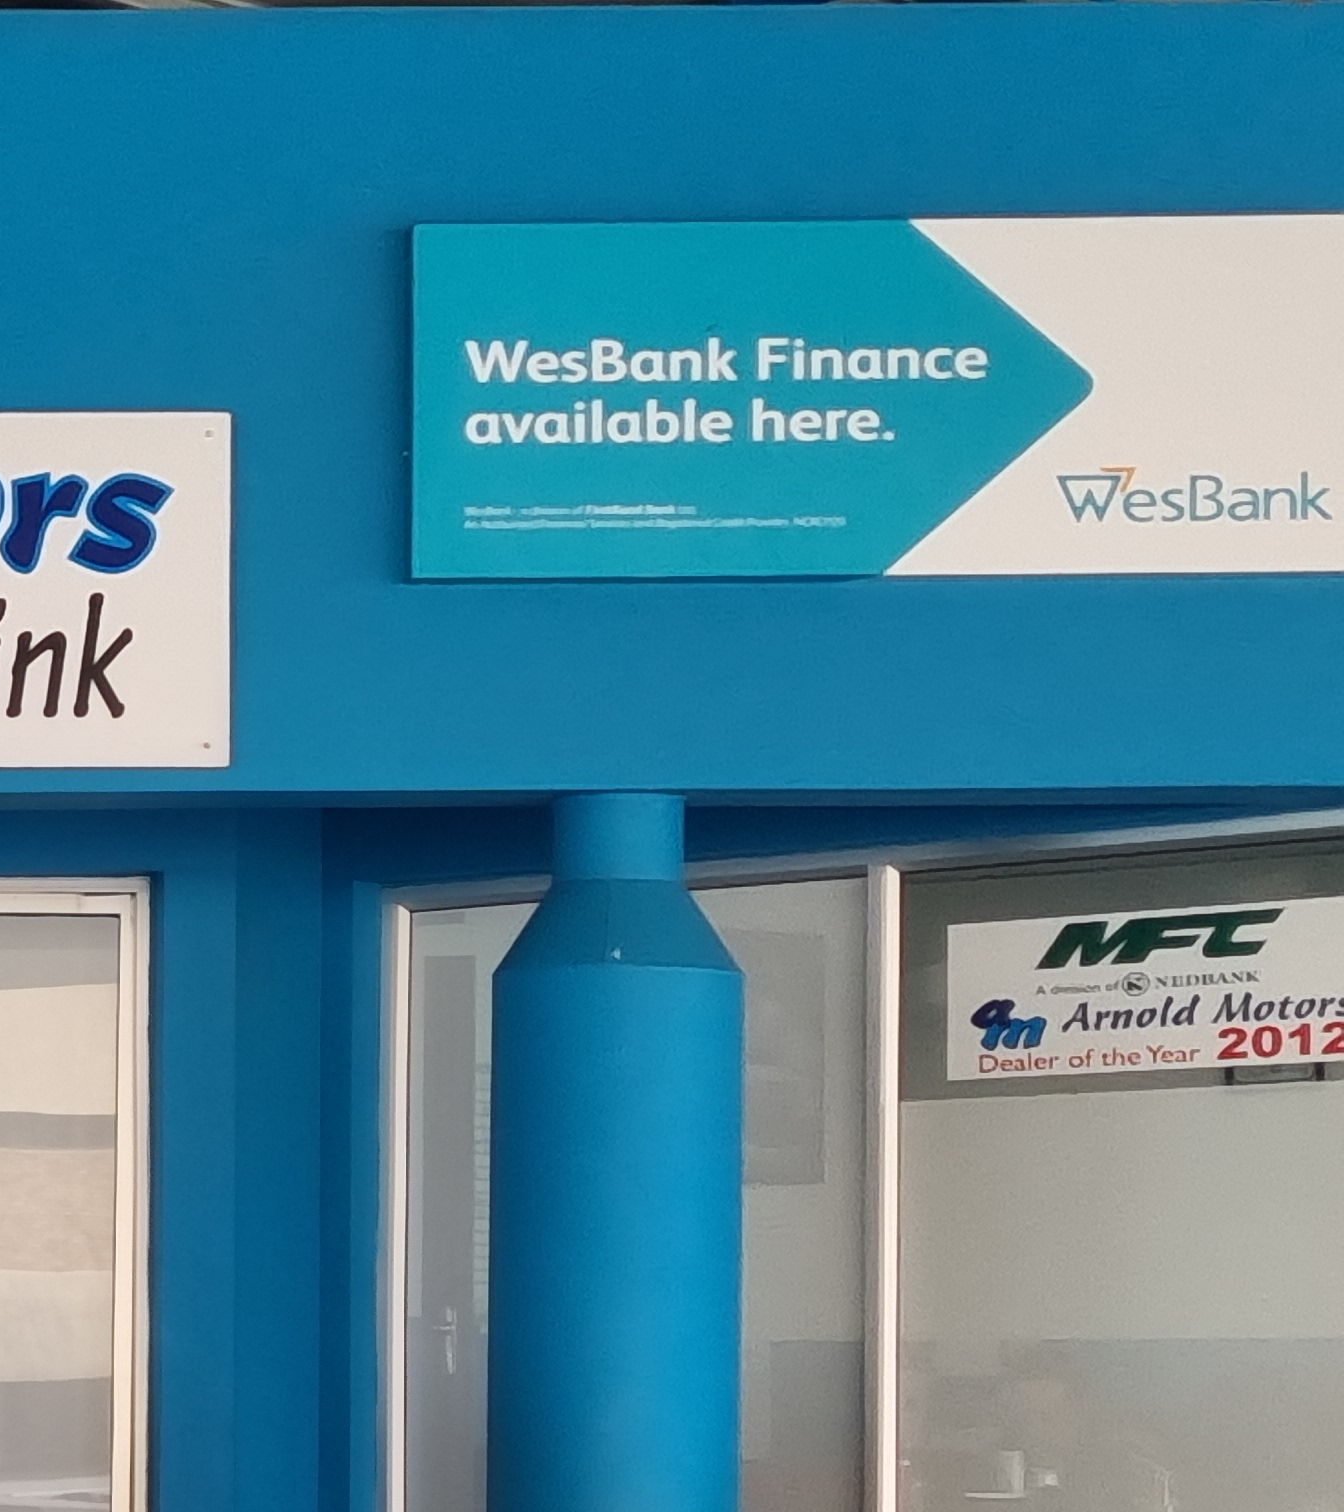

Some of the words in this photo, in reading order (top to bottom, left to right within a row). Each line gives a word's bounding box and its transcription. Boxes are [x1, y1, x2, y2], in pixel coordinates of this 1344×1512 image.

[464, 338, 738, 383] WesBank
[758, 338, 988, 381] Finance
[465, 399, 733, 444] available
[752, 398, 895, 442] here.
[1056, 466, 1333, 523] WesBank
[1034, 907, 1285, 970] MFC
[1036, 985, 1047, 996] A
[1155, 970, 1261, 990] NEDBANK
[1062, 993, 1201, 1033] Arnold
[979, 1052, 1060, 1074] Dealer
[1068, 1048, 1096, 1069] of
[1102, 1047, 1142, 1067] the
[1146, 1044, 1201, 1063] Year
[1217, 1021, 1344, 1060] 2012
